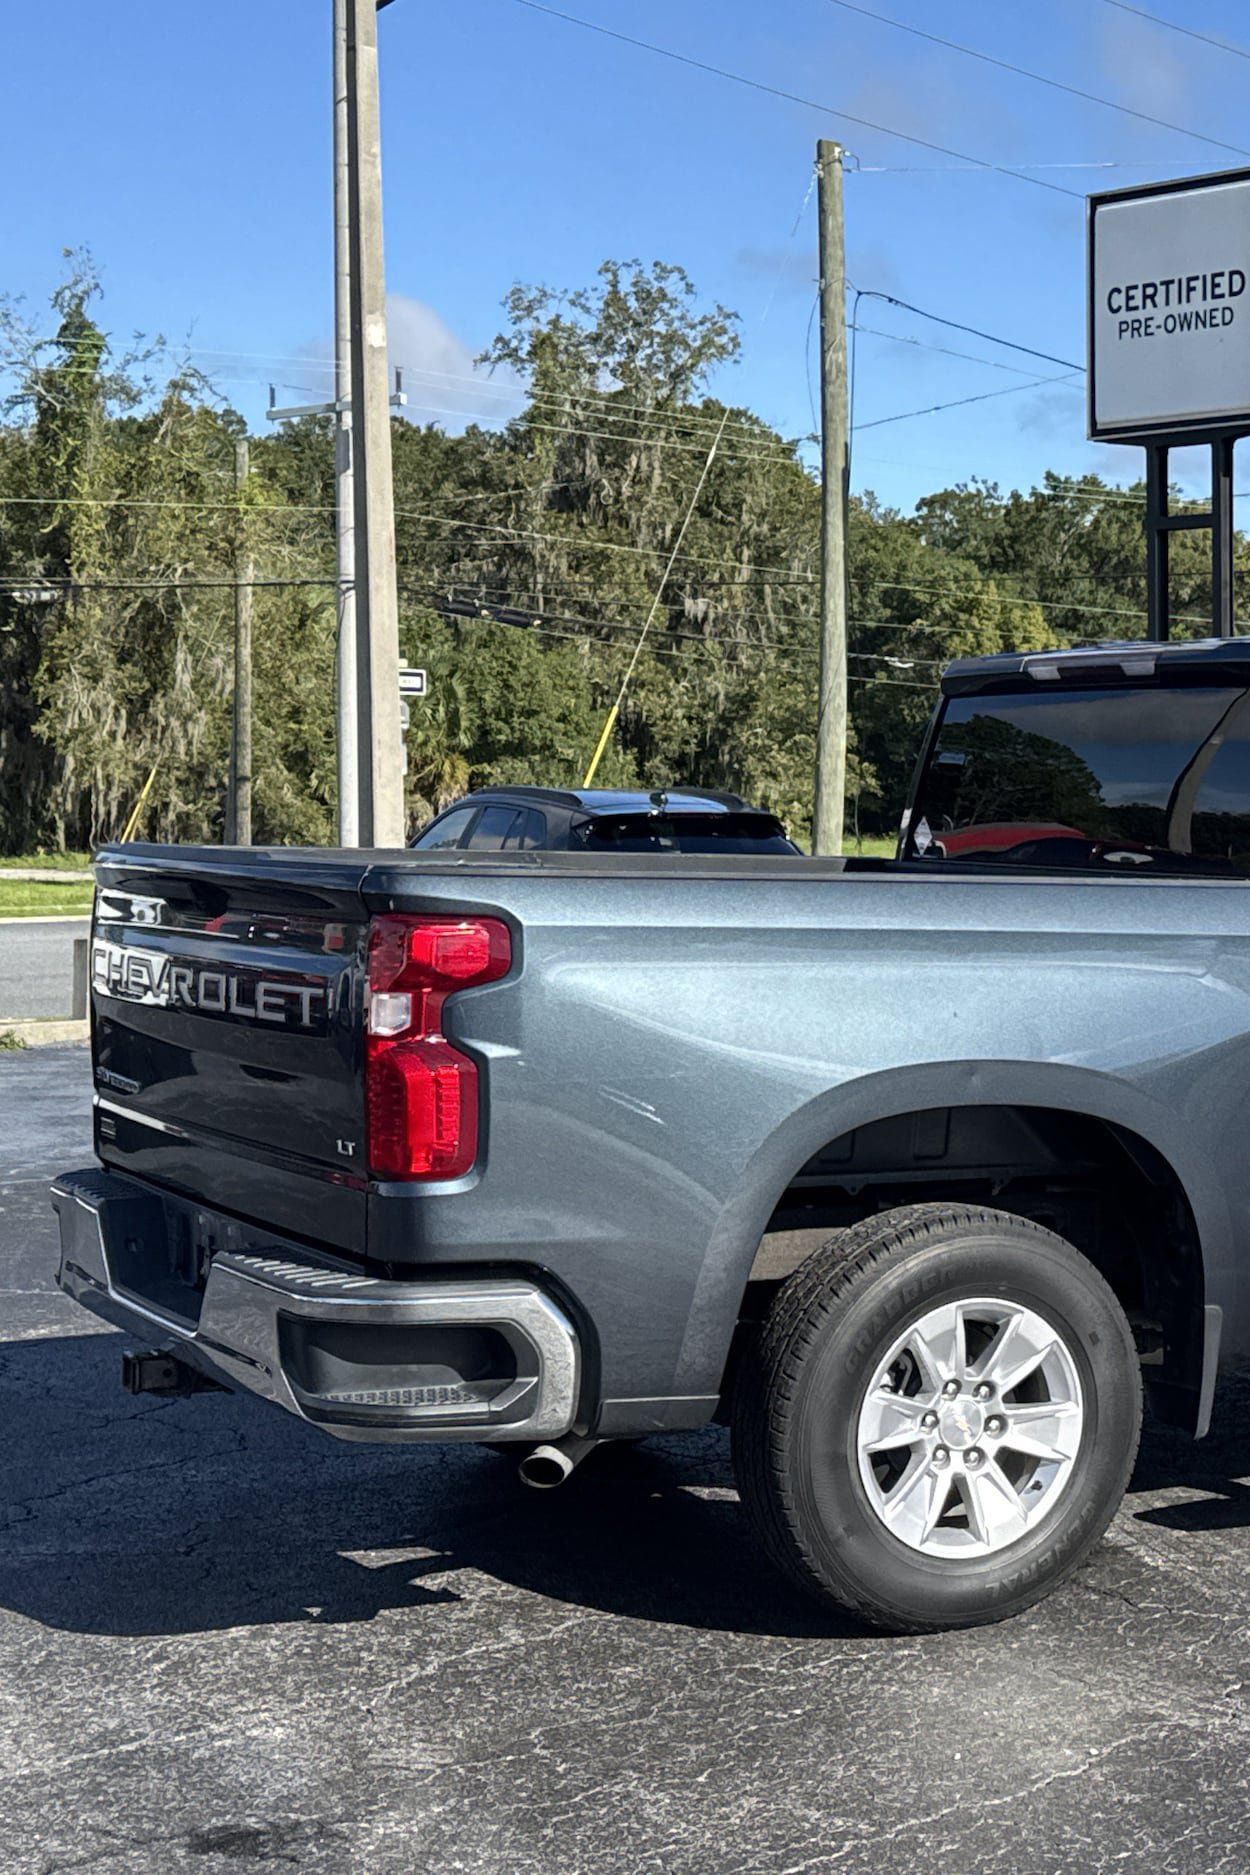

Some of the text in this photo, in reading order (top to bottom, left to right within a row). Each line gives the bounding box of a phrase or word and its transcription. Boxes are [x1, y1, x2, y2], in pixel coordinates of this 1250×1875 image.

[1107, 269, 1246, 315] CERTIFIED
[1118, 306, 1235, 341] PRE-OWNED
[92, 948, 325, 1027] CHEVROLET
[335, 1139, 356, 1156] LT
